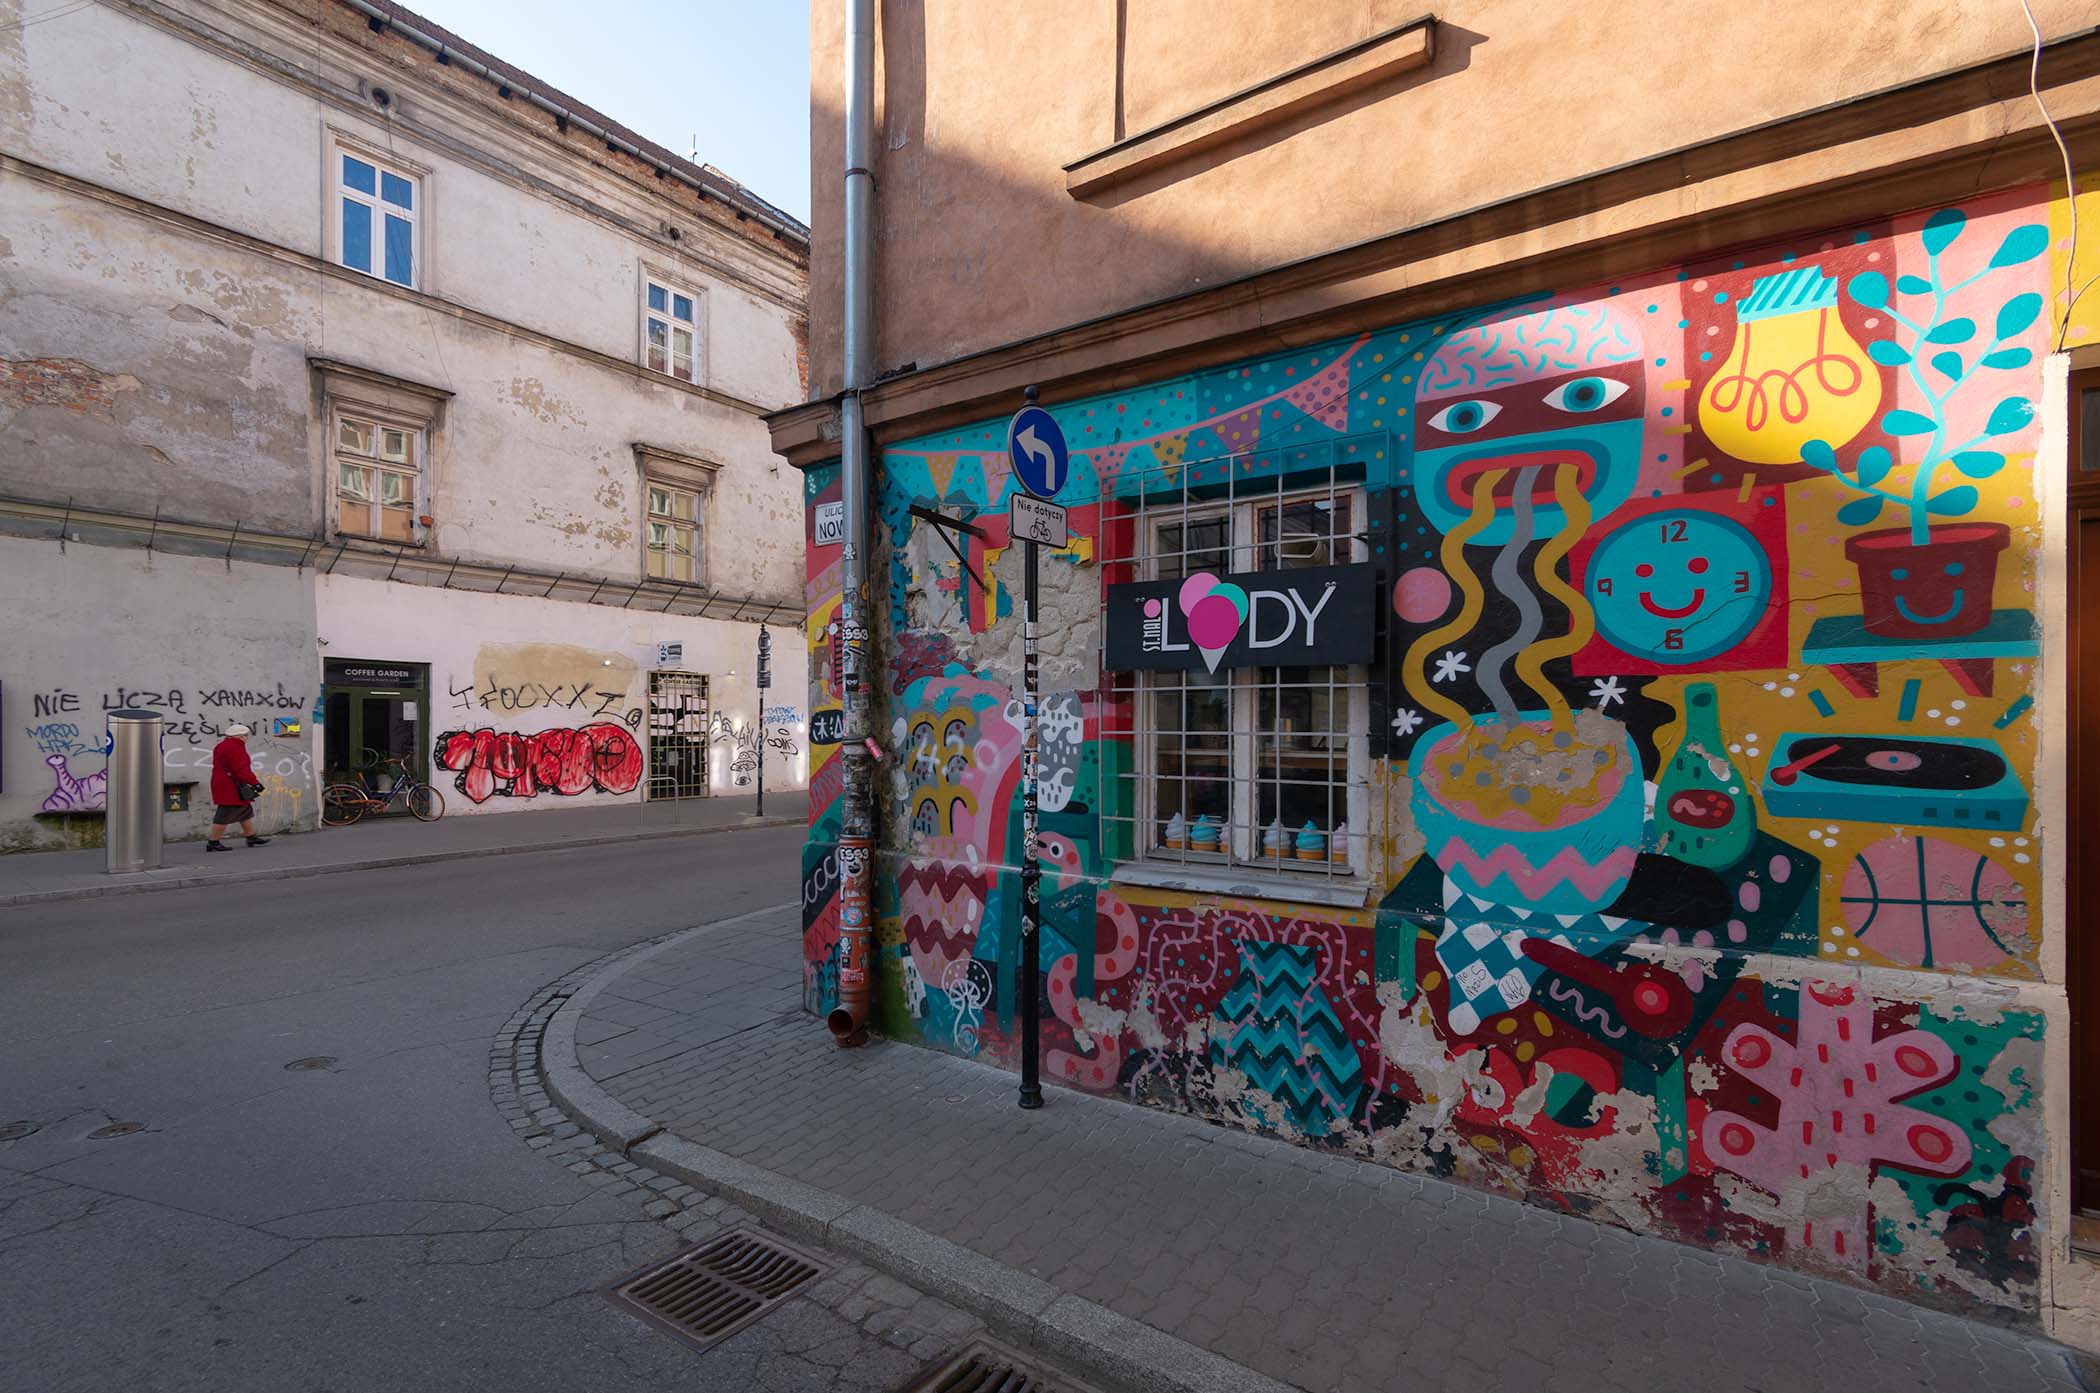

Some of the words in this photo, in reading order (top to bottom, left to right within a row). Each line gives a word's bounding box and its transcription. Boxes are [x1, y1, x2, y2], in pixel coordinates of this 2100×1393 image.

[825, 506, 845, 518] ULIC
[1017, 498, 1032, 512] Nie
[1034, 504, 1064, 523] dotyczy
[1660, 519, 1689, 544] 12
[1596, 577, 1613, 597] 9
[1734, 570, 1750, 594] 3
[1664, 628, 1684, 650] 6
[345, 668, 376, 677] COFFEE
[377, 669, 409, 678] GARDEN
